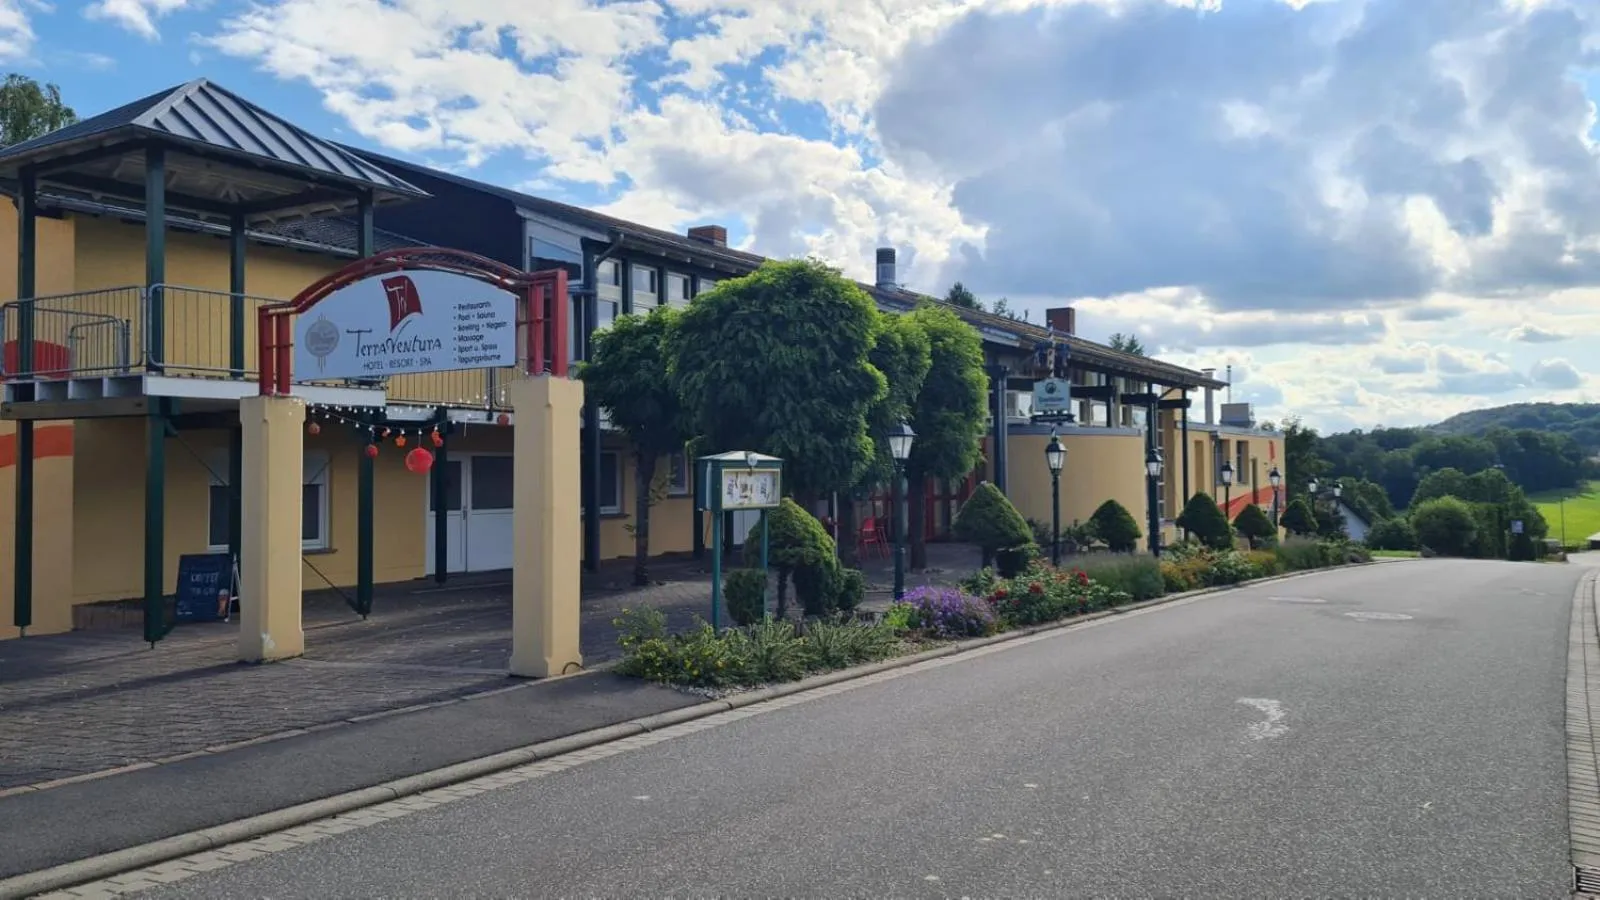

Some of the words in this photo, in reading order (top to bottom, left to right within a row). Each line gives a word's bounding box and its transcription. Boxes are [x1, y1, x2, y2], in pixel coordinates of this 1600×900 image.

[363, 360, 383, 370] HOTEL
[389, 358, 413, 369] RESORT
[419, 357, 432, 367] SPA
